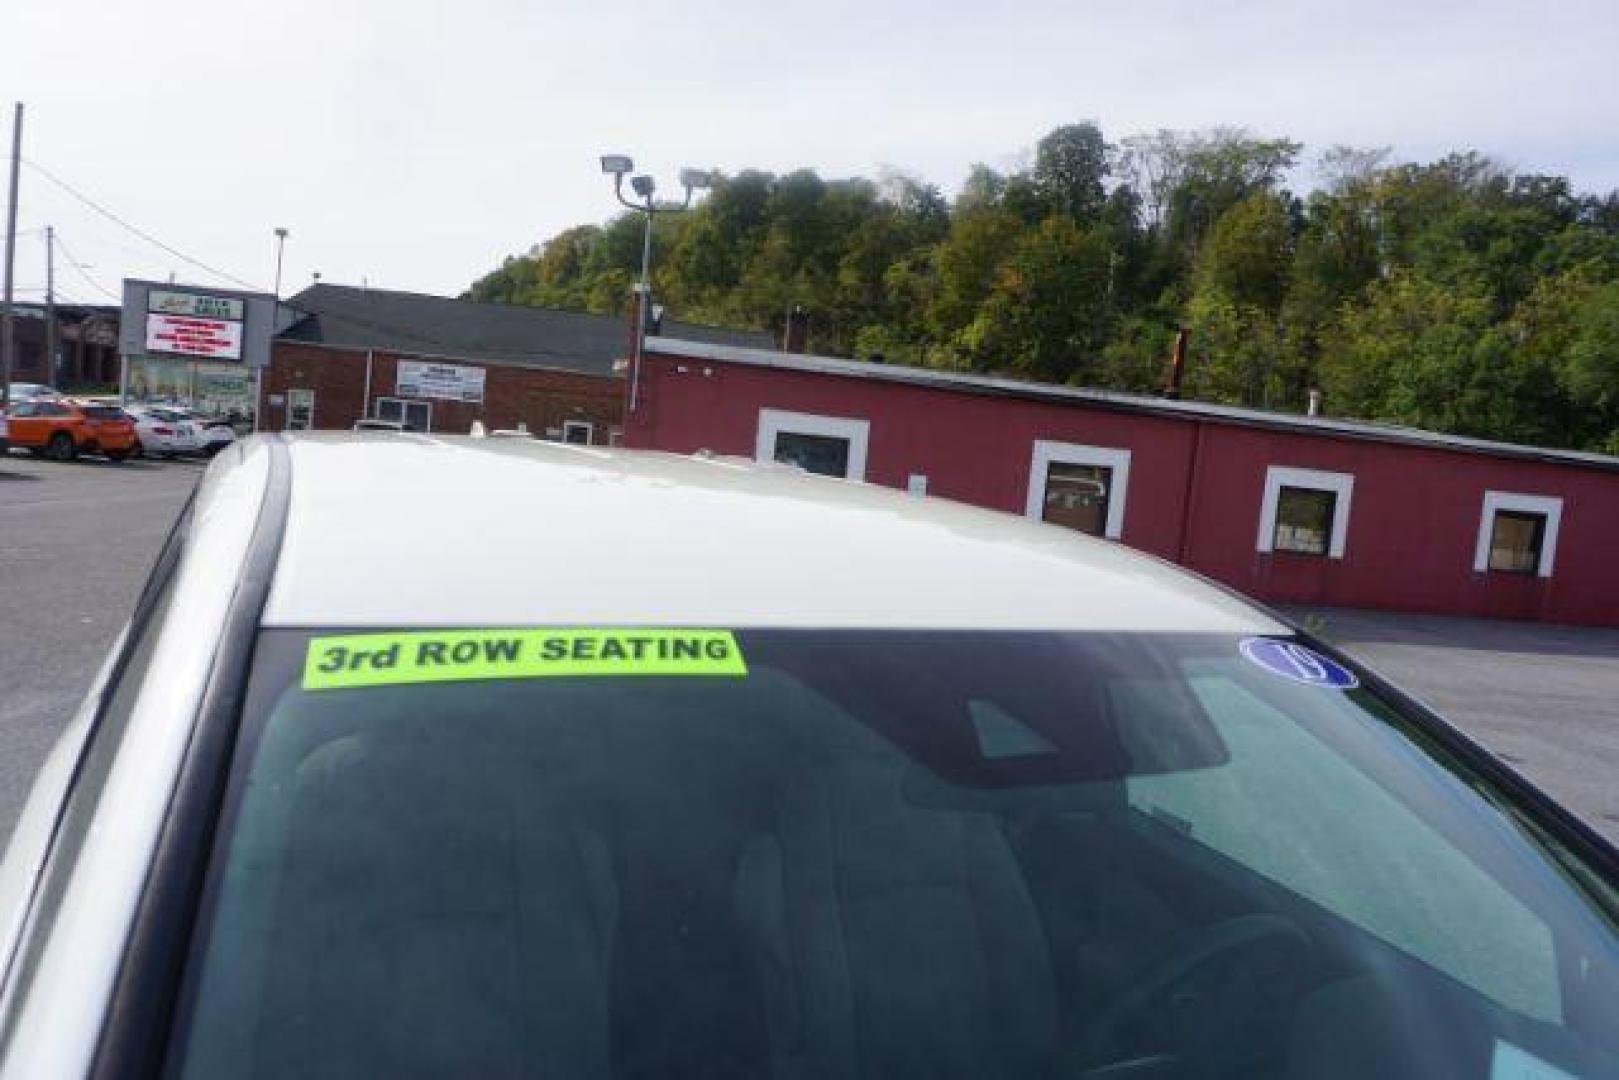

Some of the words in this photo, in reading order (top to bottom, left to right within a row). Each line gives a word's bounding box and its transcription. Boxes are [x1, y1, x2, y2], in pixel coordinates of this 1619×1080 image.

[318, 642, 402, 672] 3rd
[416, 639, 523, 665] ROW
[541, 637, 729, 660] SEATING
